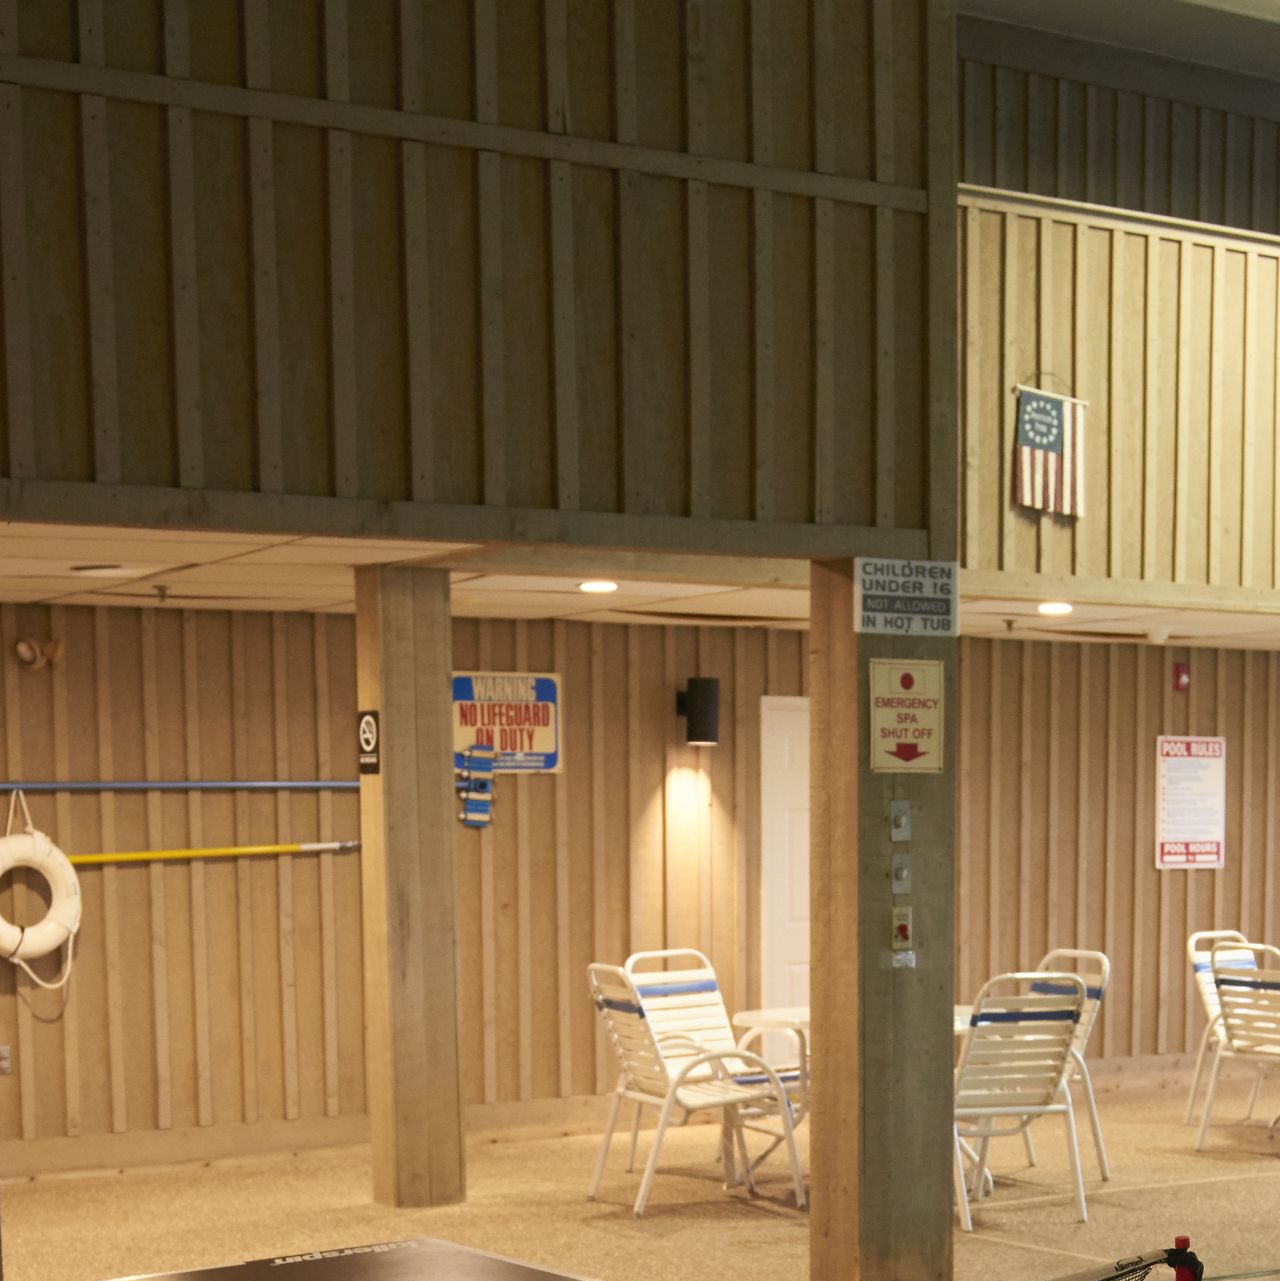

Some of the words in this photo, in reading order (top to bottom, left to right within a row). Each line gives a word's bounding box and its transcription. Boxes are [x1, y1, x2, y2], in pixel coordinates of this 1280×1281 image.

[862, 562, 952, 579] CHILDREN
[861, 579, 924, 594] UNDER
[866, 599, 888, 610] NOT
[895, 600, 946, 612] ALLOWED
[862, 615, 876, 628] IN
[884, 617, 912, 629] HOT
[921, 618, 952, 631] TUB
[875, 697, 939, 709] EMERGENCY
[459, 702, 477, 727] NO
[480, 702, 550, 727] LIFEGUARD
[896, 712, 918, 724] SPA
[476, 727, 494, 746] ON
[500, 728, 535, 752] DUTY
[880, 728, 909, 739] SHUT
[912, 729, 934, 739] OFF
[1163, 741, 1188, 756] POOL
[1191, 741, 1221, 756] RULES
[270, 1240, 419, 1267] killerspin
